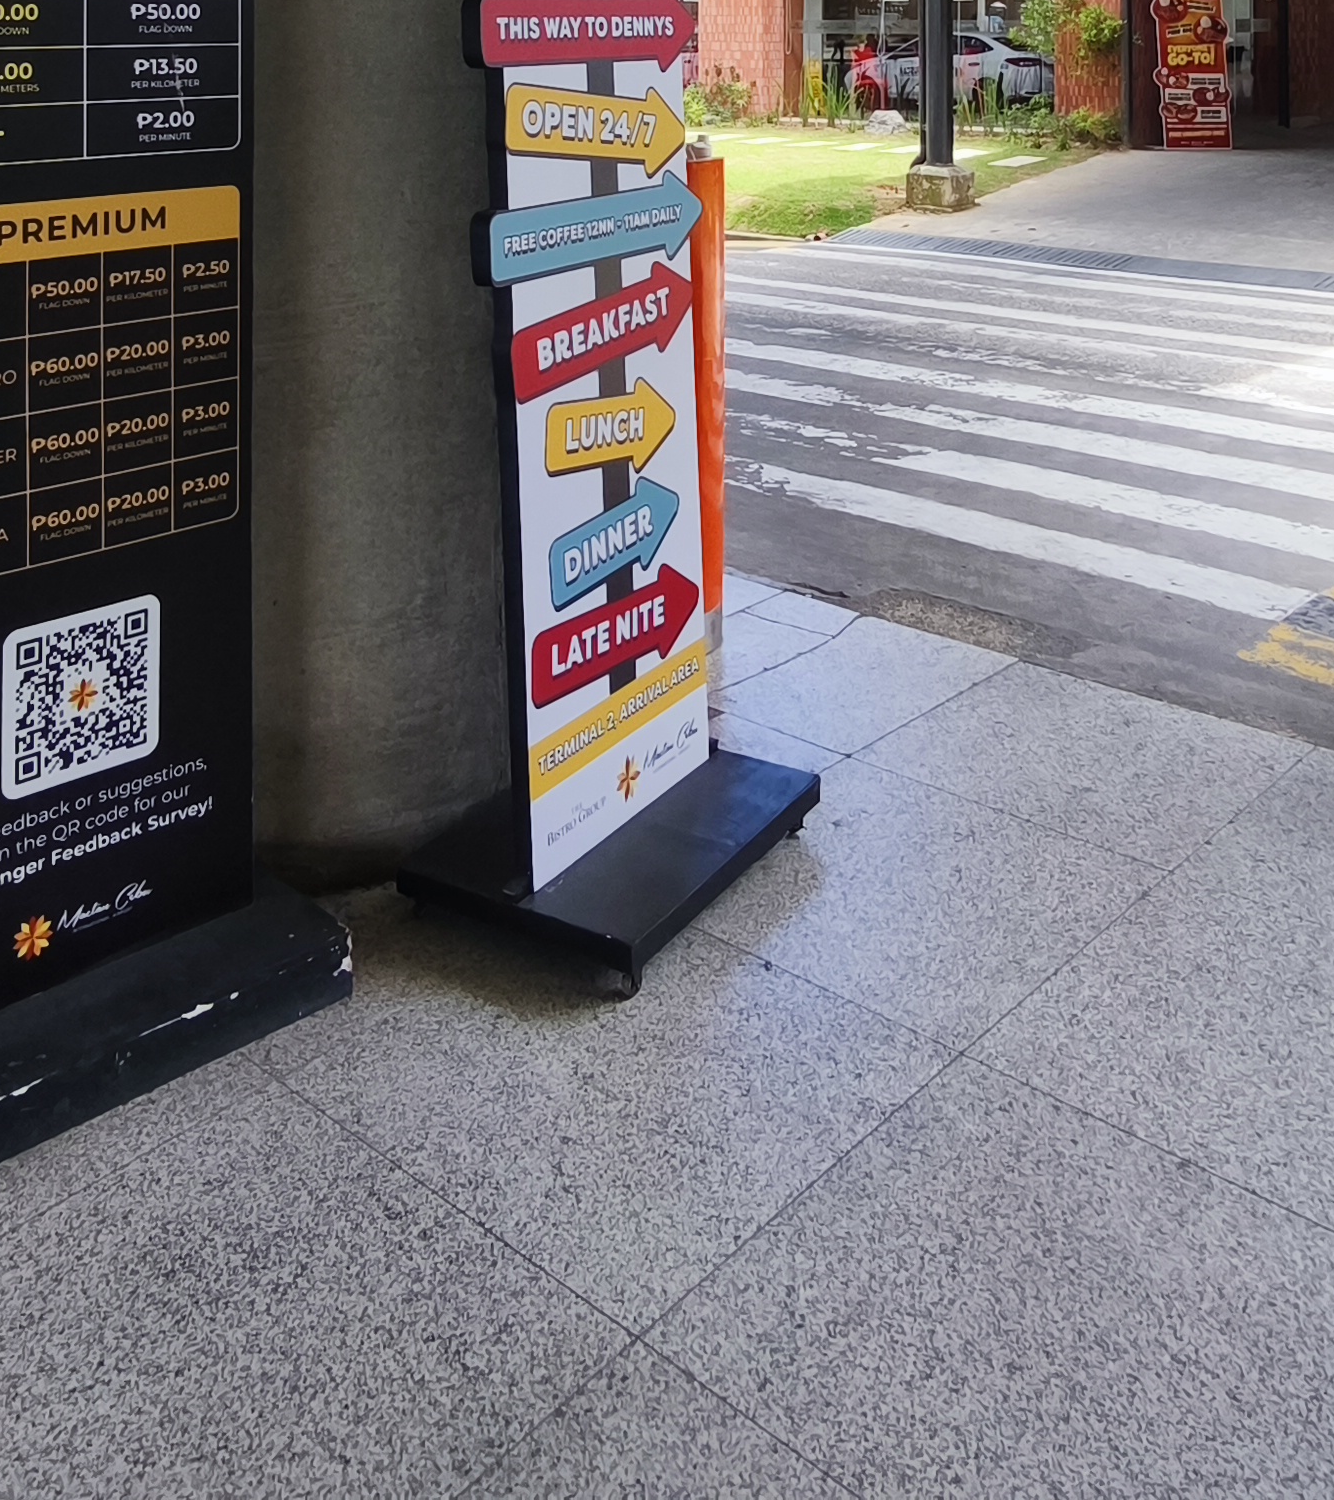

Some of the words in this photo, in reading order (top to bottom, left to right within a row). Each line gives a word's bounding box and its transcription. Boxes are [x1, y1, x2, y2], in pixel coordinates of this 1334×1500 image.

[138, 24, 162, 34] FLAG
[163, 23, 193, 34] DOWN
[496, 17, 540, 40] THIS
[544, 16, 583, 39] WAY
[585, 16, 608, 38] TO
[611, 15, 675, 38] DENNYS
[1167, 49, 1216, 66] GO-TO!
[0, 83, 40, 94] METERS
[130, 80, 149, 89] PER
[150, 78, 200, 88] KILOMETER
[139, 133, 157, 143] PER
[158, 132, 192, 142] MINUTE
[522, 100, 594, 142] OPEN
[600, 109, 657, 148] 24/7
[503, 232, 537, 257] FREE
[538, 223, 586, 249] COFFEE
[586, 217, 615, 240] 12NN
[623, 213, 651, 232] 11AM
[651, 203, 683, 227] DAILY
[39, 301, 61, 310] FLAG
[62, 297, 90, 307] DOWN
[536, 287, 670, 371] BREAKFAST
[39, 377, 61, 386] FLAG
[62, 373, 91, 384] DOWN
[565, 407, 645, 454] LUNCH
[39, 454, 62, 464] FLAG
[62, 449, 91, 460] DOWN
[40, 531, 62, 541] FLAG
[63, 524, 92, 537] DOWN
[563, 505, 654, 585] DINNER
[551, 618, 611, 678] LATE
[615, 594, 666, 646] NITE
[538, 721, 605, 776] TERMINAL
[606, 712, 618, 732] 2,
[617, 684, 669, 722] ARRIVAL
[668, 656, 700, 689] AREA
[75, 794, 94, 812] or
[98, 756, 208, 804] suggestions,
[16, 832, 47, 855] the
[52, 818, 81, 843] QR
[85, 804, 129, 831] code
[133, 793, 158, 815] for
[161, 784, 191, 806] our
[51, 823, 143, 867] Feedback
[147, 796, 214, 835] Survey!
